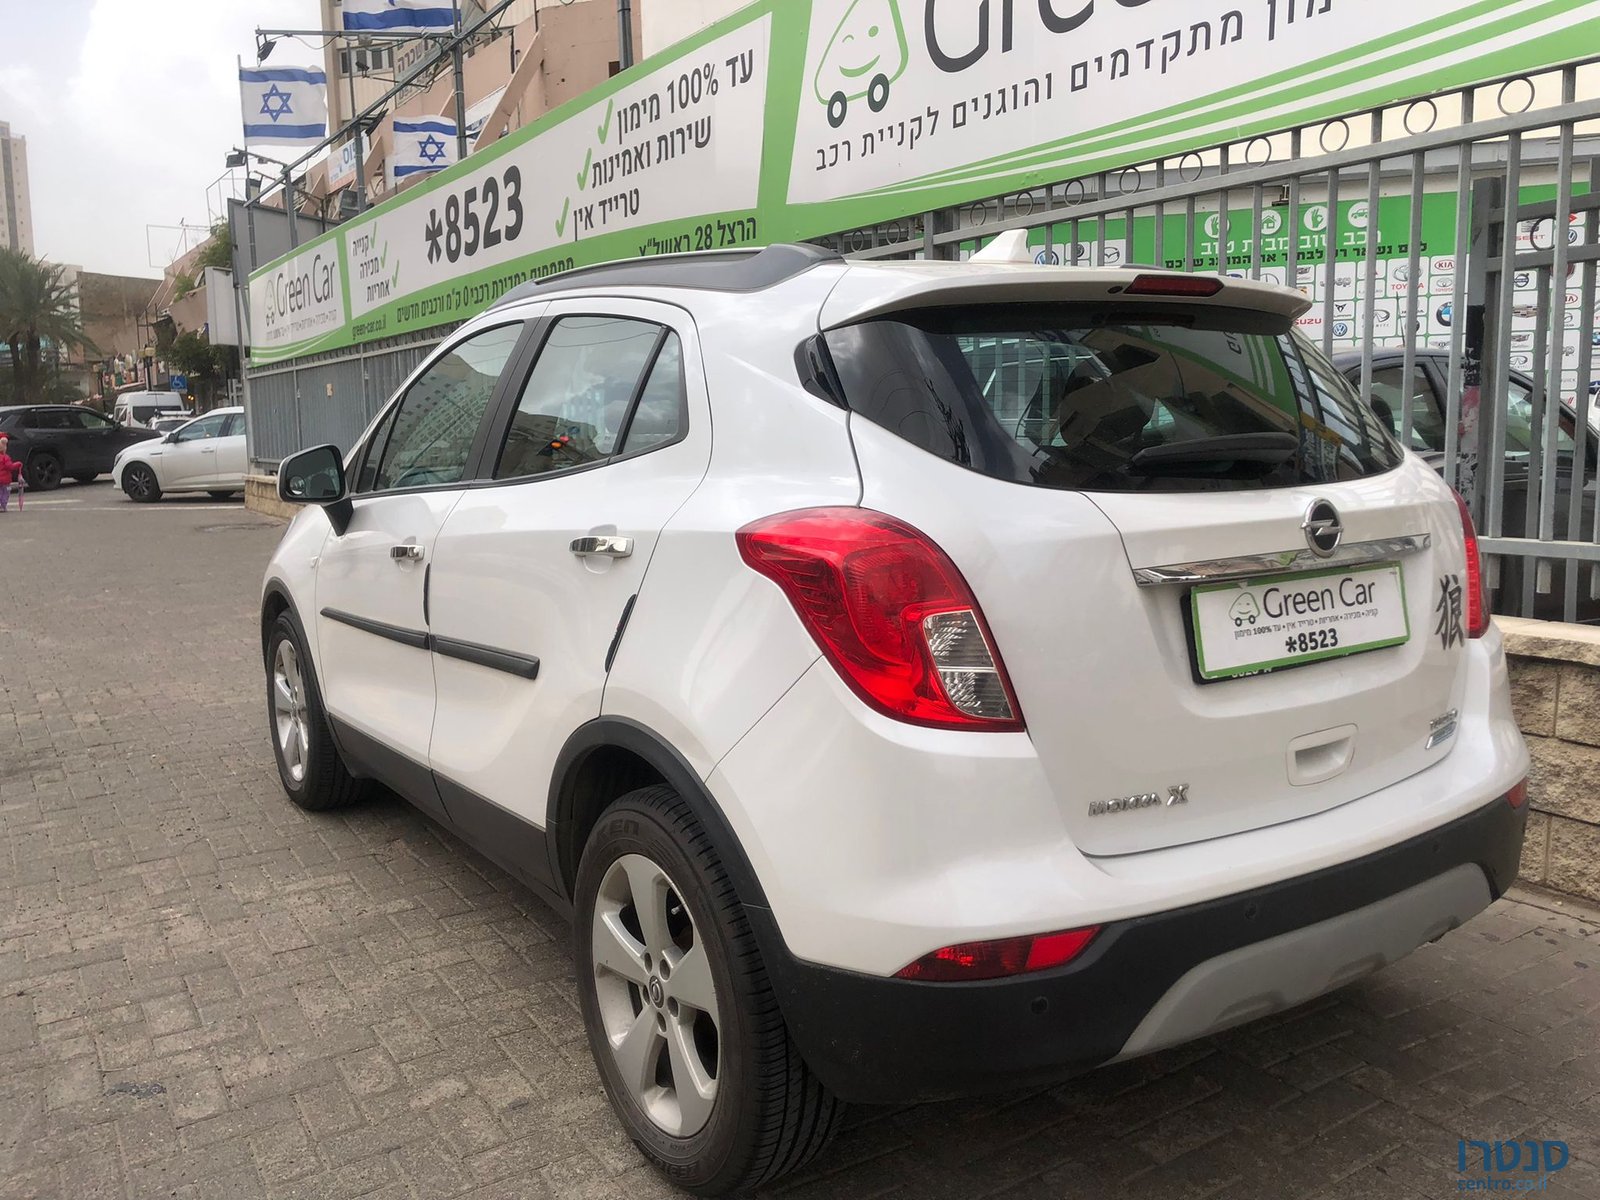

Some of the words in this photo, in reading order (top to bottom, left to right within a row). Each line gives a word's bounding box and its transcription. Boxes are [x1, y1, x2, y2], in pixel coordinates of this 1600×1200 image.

[725, 48, 754, 88] עד
[1070, 10, 1243, 92] מתקדמים
[666, 62, 719, 115] 100%
[952, 72, 1052, 129] והוגנים
[616, 92, 661, 146] מימון
[861, 106, 940, 150] לקניית
[655, 115, 712, 165] שירות
[815, 139, 851, 171] רכב
[591, 140, 651, 189] ואמינות
[573, 203, 594, 242] אין
[597, 187, 640, 225] טרייד
[694, 223, 713, 252] 28
[717, 216, 757, 247] הרצל
[1437, 261, 1454, 269] KIA
[276, 272, 311, 318] Green
[312, 254, 335, 304] Car
[1263, 586, 1335, 620] Green
[1339, 577, 1376, 608] Car
[1253, 626, 1272, 636] 100%
[1166, 783, 1190, 806] X
